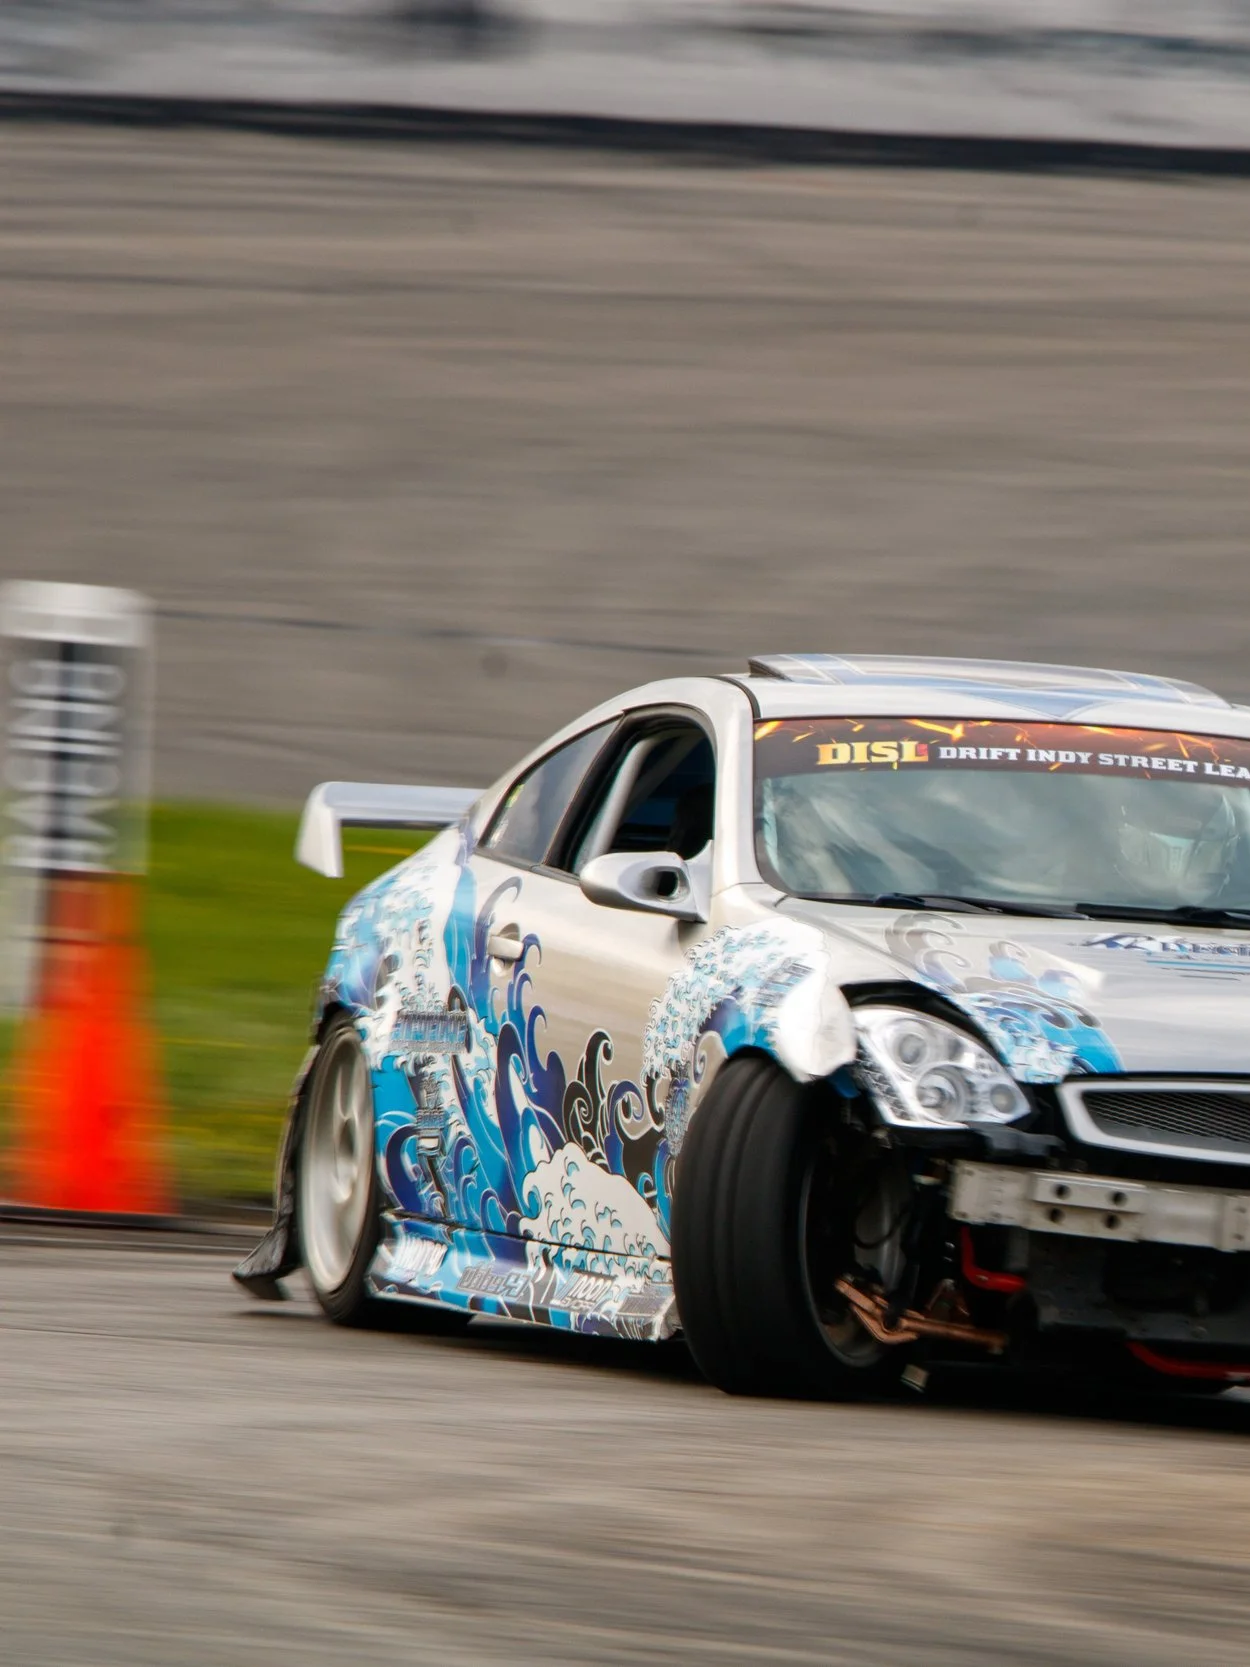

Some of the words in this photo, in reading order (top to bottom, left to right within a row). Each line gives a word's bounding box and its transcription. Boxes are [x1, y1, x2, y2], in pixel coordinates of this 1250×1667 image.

[817, 741, 928, 765] DISL
[939, 747, 1020, 760] DRIFT
[1027, 748, 1092, 764] INDY
[1098, 753, 1198, 774] STREET
